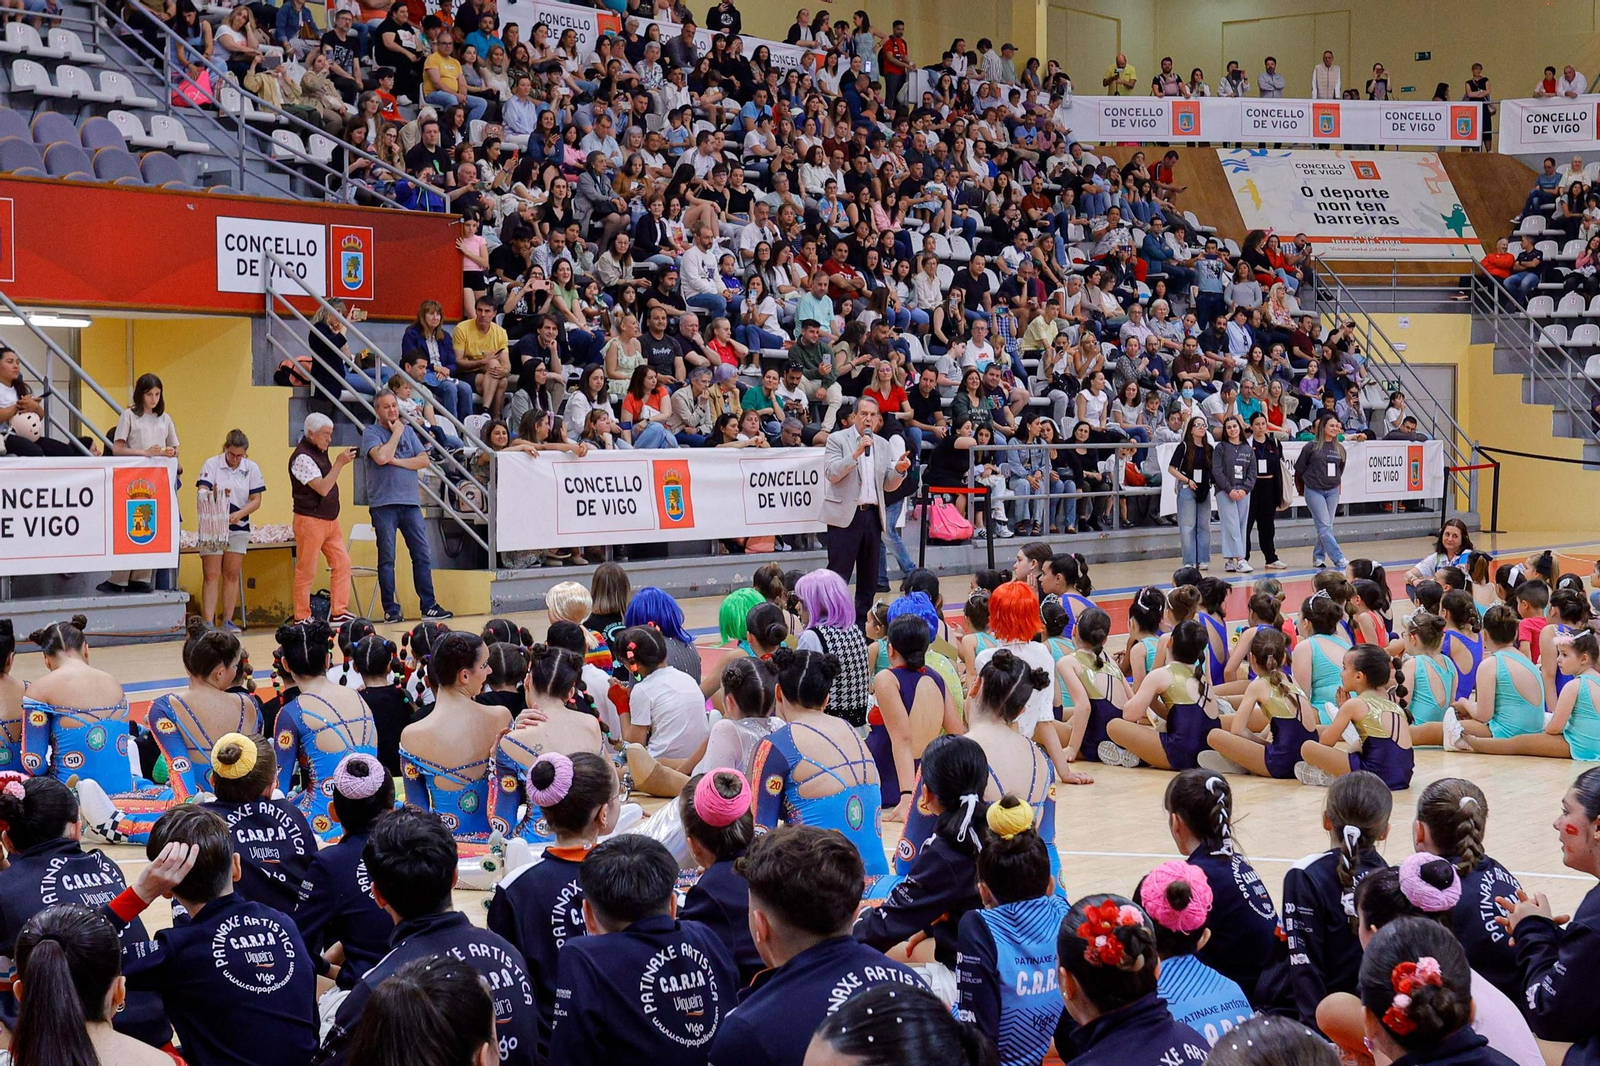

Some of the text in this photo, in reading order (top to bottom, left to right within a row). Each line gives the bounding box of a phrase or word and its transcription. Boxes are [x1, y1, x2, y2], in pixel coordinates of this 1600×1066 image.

[539, 12, 591, 31] CONCELLO
[1104, 107, 1164, 117] CONCELLO
[1246, 108, 1304, 118] CONCELLO
[1385, 111, 1442, 121] CONCELLO
[1526, 111, 1587, 123] CONCELLO
[1111, 118, 1157, 128] DE VIGO
[1253, 120, 1298, 129] DE VIGO
[1392, 122, 1436, 132] DE VIGO
[1533, 123, 1580, 134] DE VIGO
[1300, 186, 1390, 201] O deporte
[1317, 200, 1387, 212] non ten
[1313, 212, 1400, 226] barreiras
[225, 233, 317, 257] CONCELLO
[237, 258, 259, 277] DE
[1368, 456, 1403, 468] CONCELLO
[749, 470, 819, 488] CONCELLO
[1372, 470, 1399, 482] DE VIGO
[564, 475, 642, 494] CONCELLO
[1, 487, 94, 510] NCELLO
[758, 490, 812, 509] DE VIGO
[576, 498, 637, 517] DE VIGO
[1, 515, 80, 538] E VIGO
[32, 713, 43, 722] 20
[160, 721, 173, 730] 20
[91, 733, 102, 744] 30
[280, 736, 290, 745] 20
[26, 758, 37, 768] 50
[67, 756, 79, 764] 50
[174, 761, 187, 769] 50
[407, 767, 417, 775] 20
[325, 782, 334, 791] 50
[504, 780, 515, 788] 20
[770, 779, 781, 790] 20
[463, 796, 475, 808] 30
[851, 806, 860, 820] 30
[259, 801, 305, 856] ARTISTICA
[315, 819, 328, 830] 20
[492, 821, 503, 832] 50
[899, 842, 910, 853] 50
[1479, 870, 1505, 943] PATINAXE
[1494, 867, 1520, 890] ARTIS
[551, 879, 583, 949] PATINAX
[212, 915, 295, 968] PATINAXE ARTISTICA
[1015, 955, 1053, 966] PATINAXE
[255, 972, 275, 985] Vigo
[468, 943, 533, 1005] ARTISTICA
[639, 942, 718, 1014] PATINAXE ARTISTICA
[864, 966, 925, 988] ARTIST
[1016, 968, 1060, 996] C.A.R.
[492, 998, 512, 1016] eira
[685, 1022, 704, 1037] Vigo
[498, 1035, 518, 1060] go
